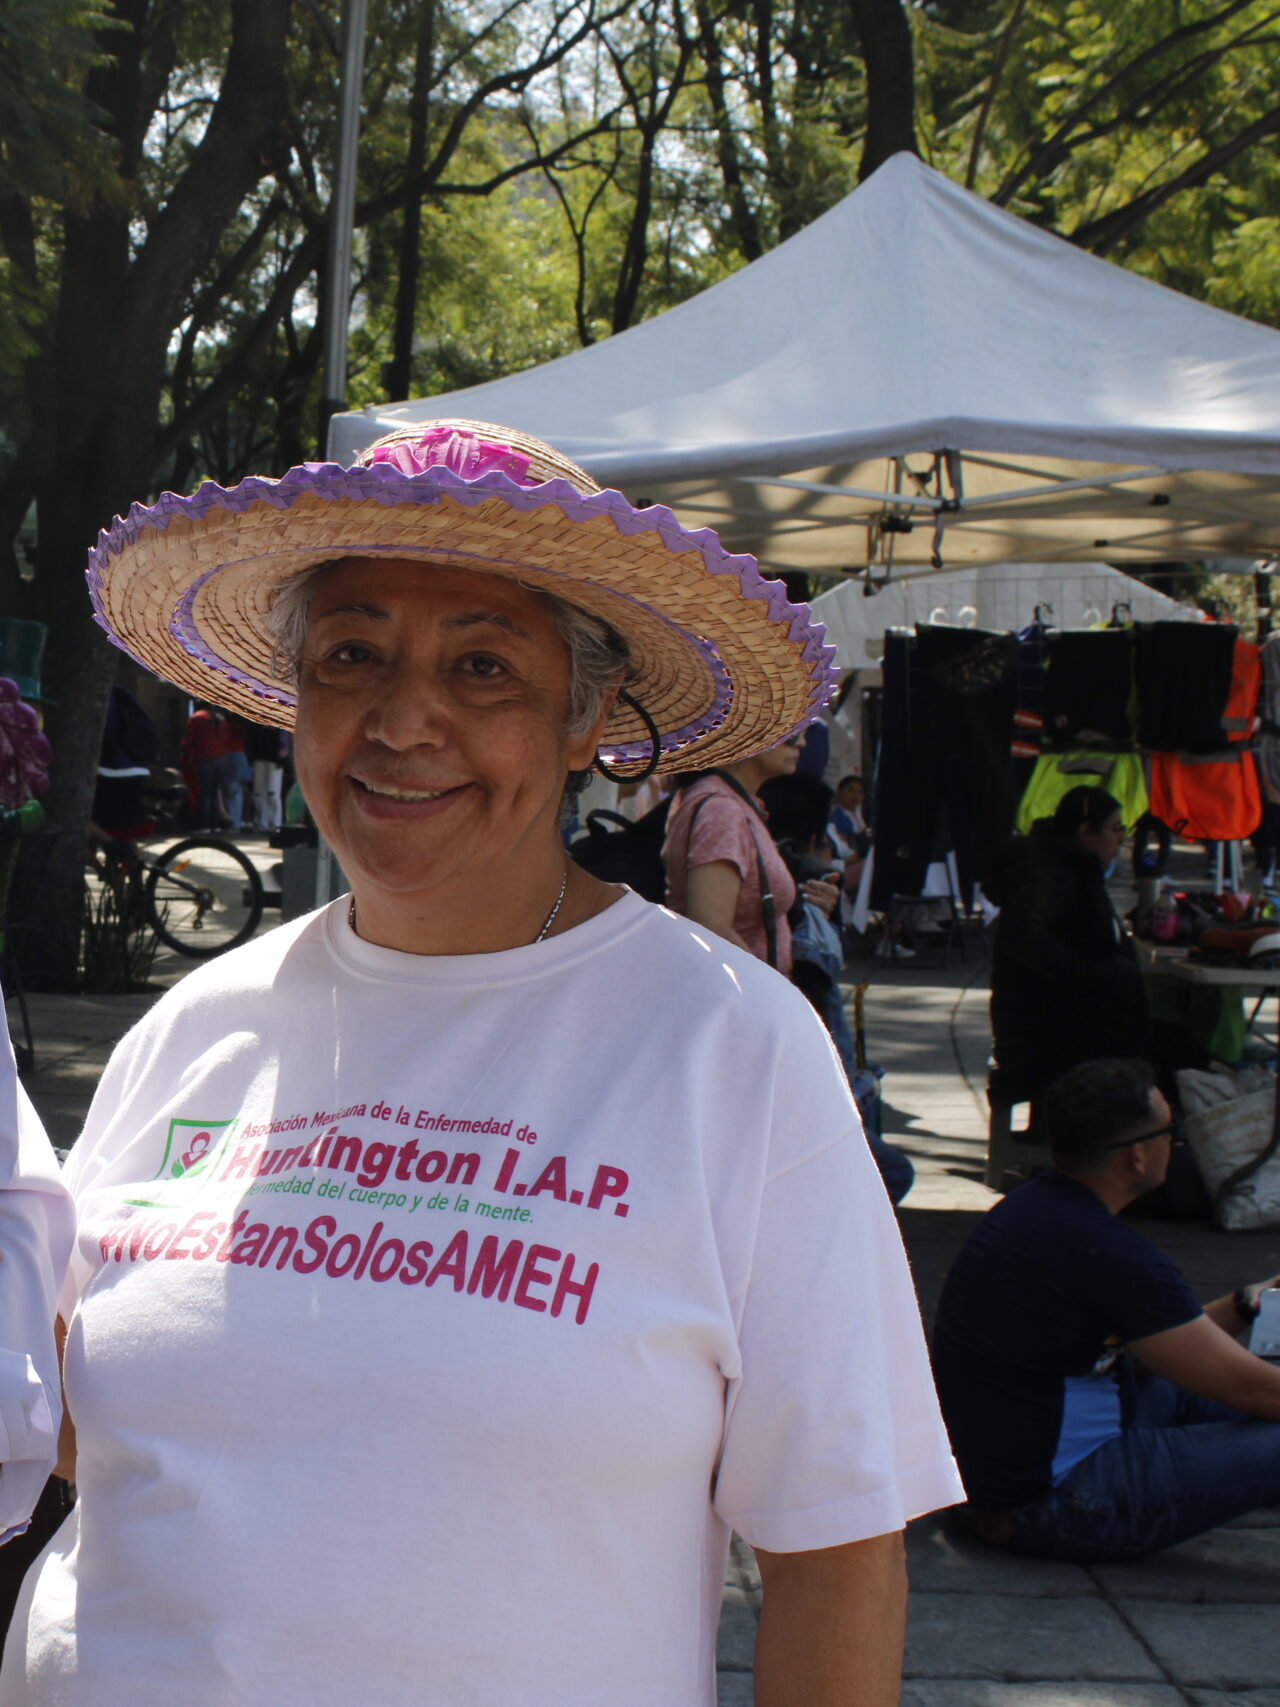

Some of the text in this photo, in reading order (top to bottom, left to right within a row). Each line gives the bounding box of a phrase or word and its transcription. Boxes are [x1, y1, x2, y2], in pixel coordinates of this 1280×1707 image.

[240, 1100, 538, 1145] Asociación Mexicana de la Enfermedad de
[219, 1126, 630, 1218] Huntington I.A.P.
[317, 1178, 346, 1200] del
[349, 1187, 408, 1210] cuerpo
[408, 1194, 424, 1213] y
[427, 1191, 449, 1211] de
[453, 1193, 470, 1213] la
[475, 1201, 535, 1223] mente.
[99, 1209, 600, 1326] #NoEstanSolosAMEH
